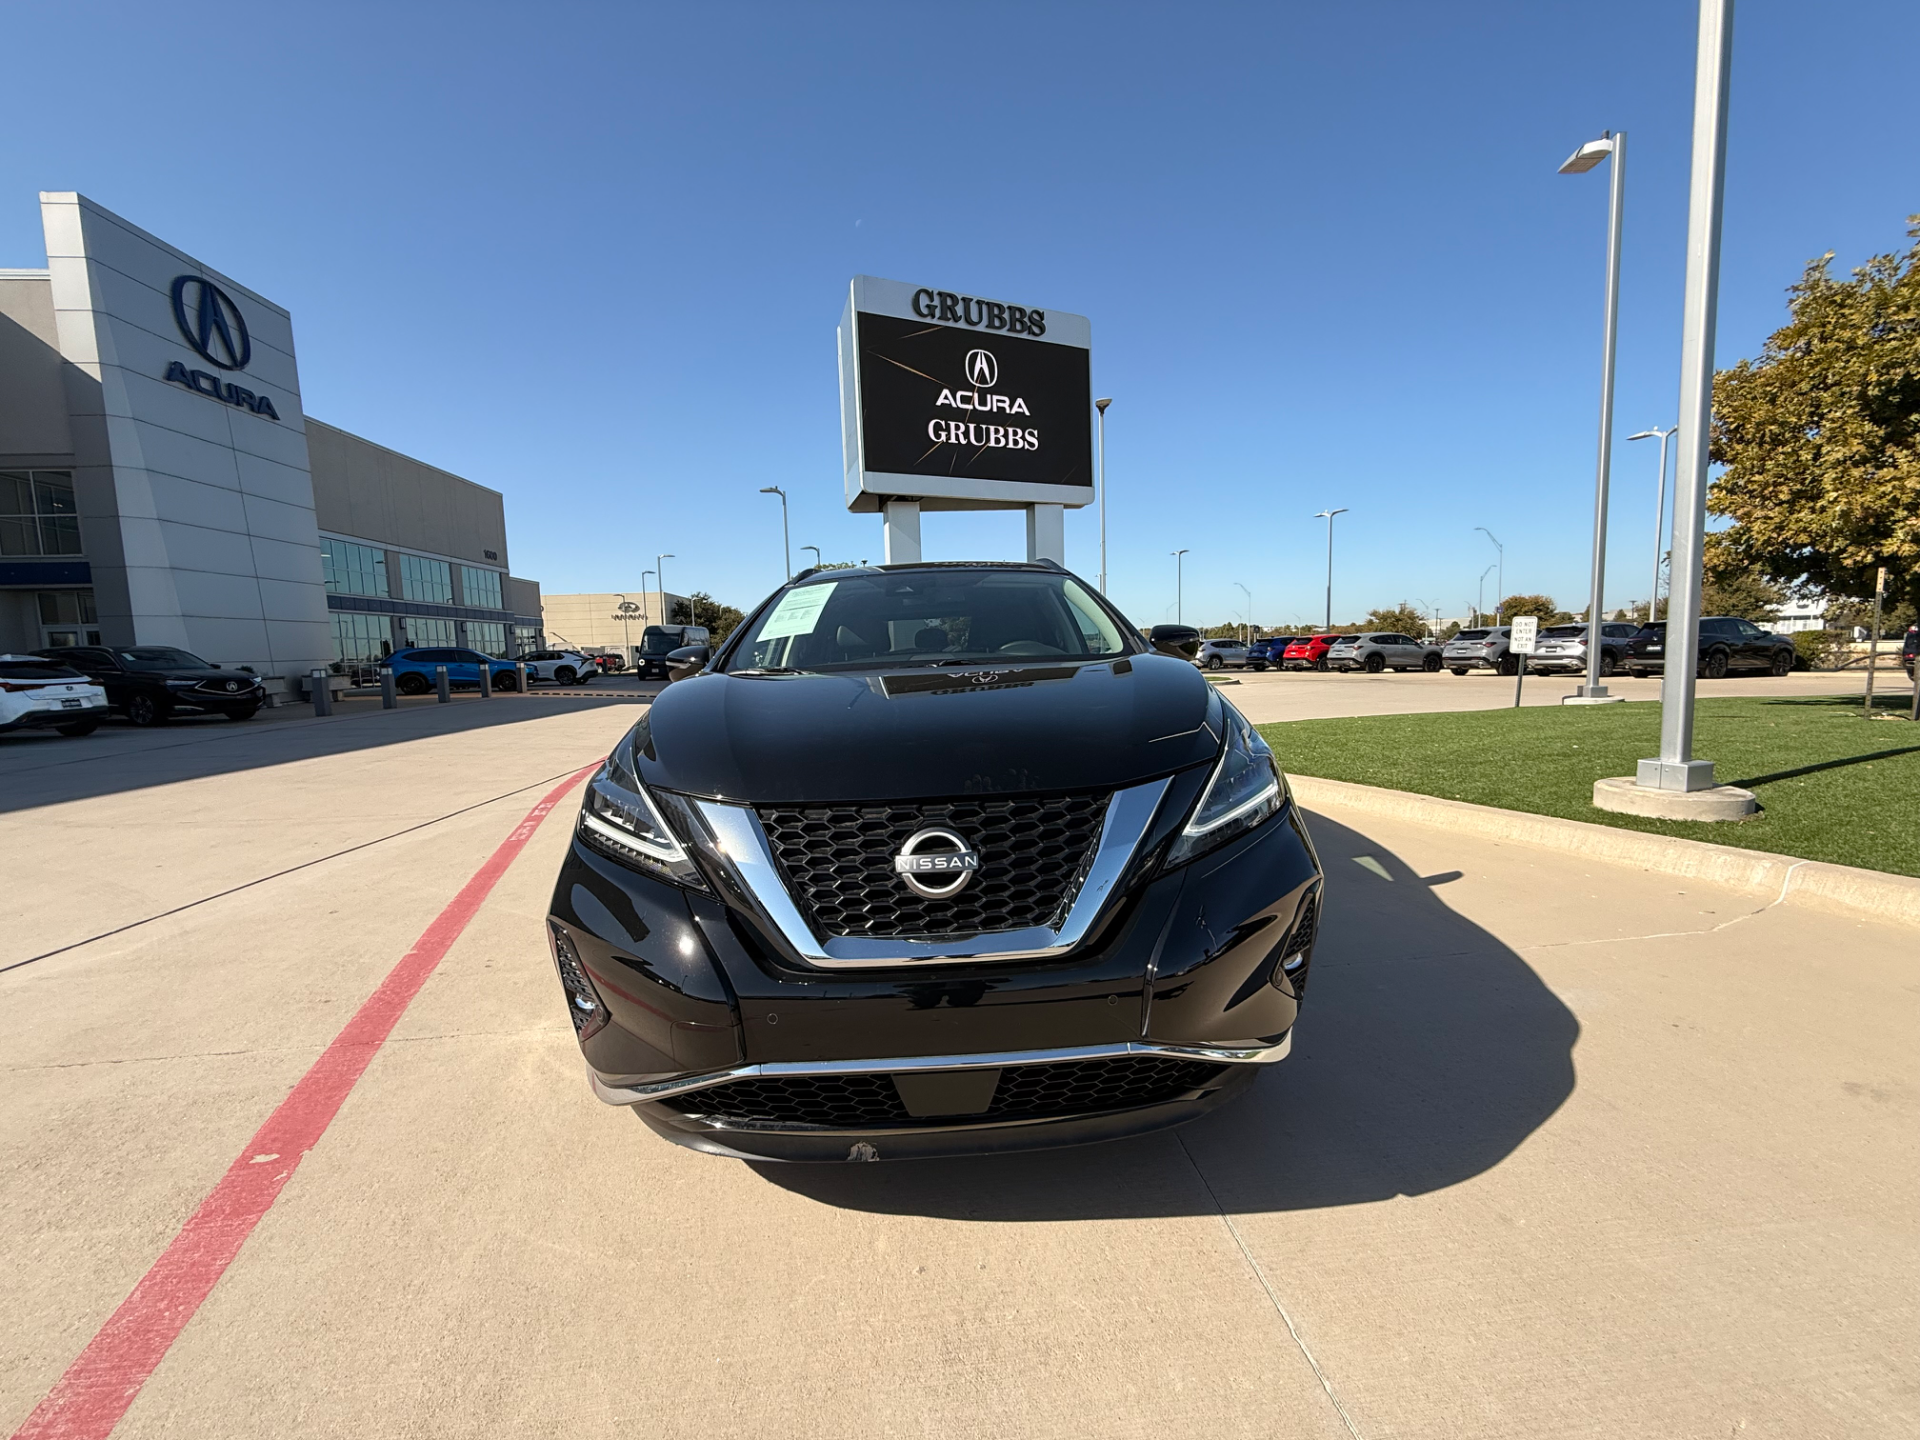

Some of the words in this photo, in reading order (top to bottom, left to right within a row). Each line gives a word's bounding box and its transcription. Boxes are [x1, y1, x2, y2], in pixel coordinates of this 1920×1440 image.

[911, 288, 1046, 337] GRUBBS
[163, 360, 281, 421] ACURA
[935, 388, 1031, 416] ACURA
[927, 418, 1039, 451] GRUBBS
[897, 855, 978, 870] NISSAN
